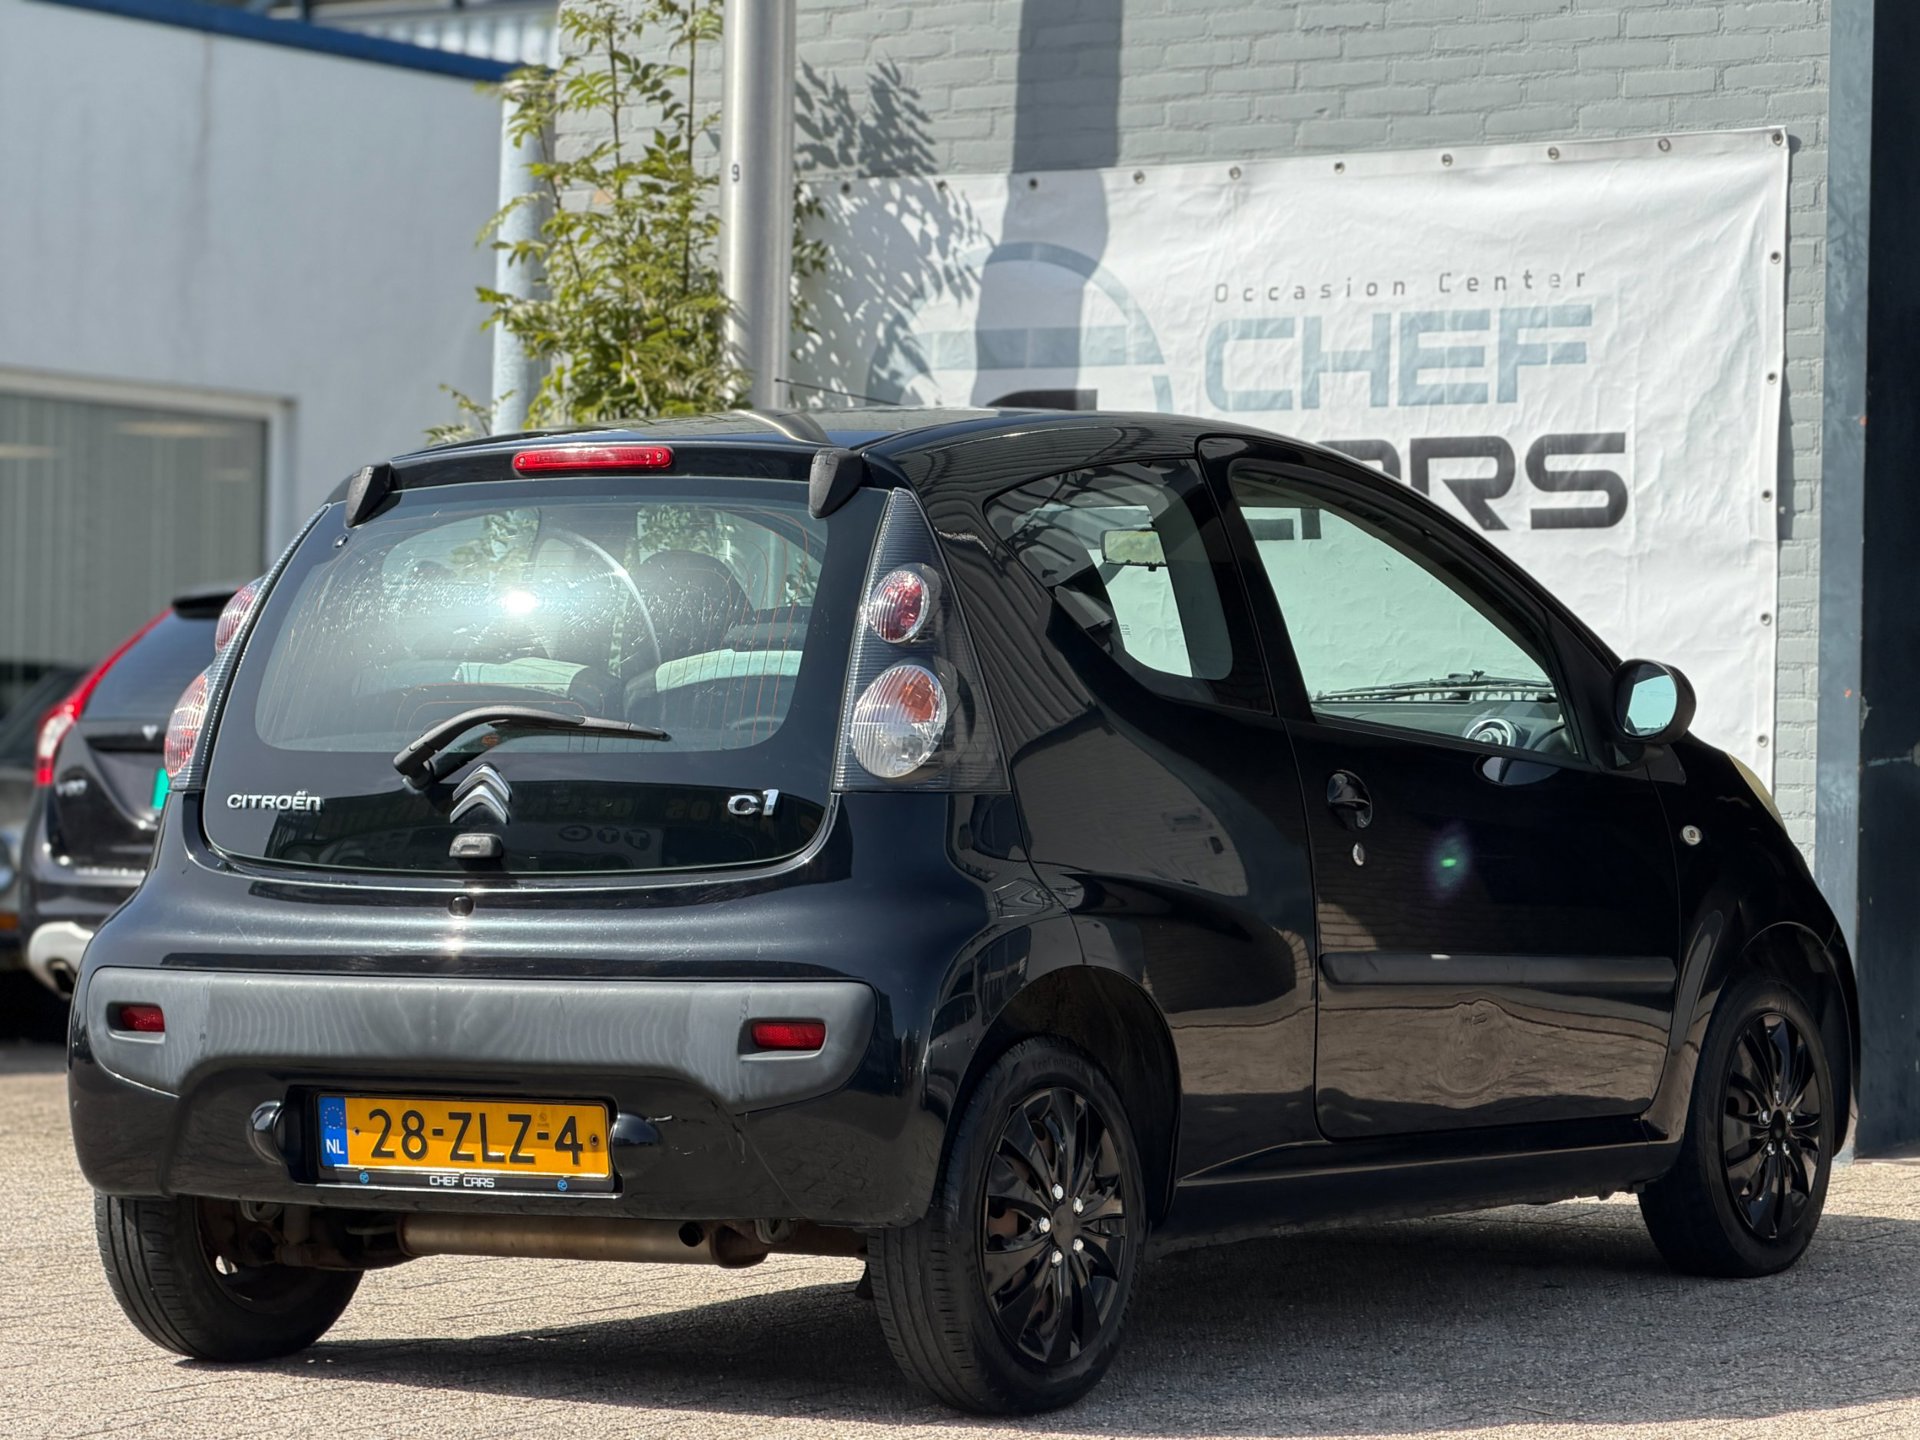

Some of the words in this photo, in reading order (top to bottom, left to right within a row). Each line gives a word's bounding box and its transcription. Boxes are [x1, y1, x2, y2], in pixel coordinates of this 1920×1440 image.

[1214, 277, 1406, 303] Occasion
[1438, 271, 1586, 294] Center
[1205, 305, 1593, 412] CHEF
[727, 788, 779, 816] C1
[325, 1138, 345, 1155] NL
[368, 1108, 584, 1166] 28-ZLZ-4
[429, 1175, 460, 1187] CHEF
[463, 1176, 496, 1189] CARS
